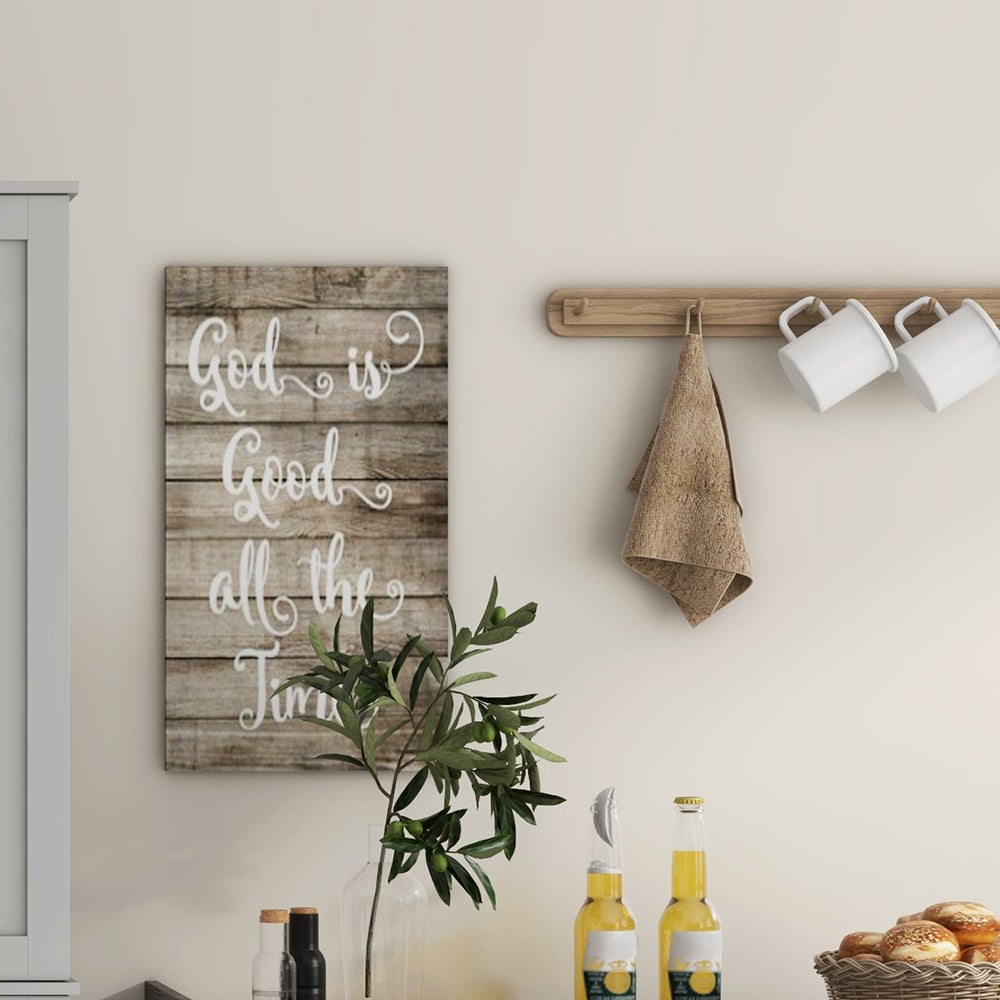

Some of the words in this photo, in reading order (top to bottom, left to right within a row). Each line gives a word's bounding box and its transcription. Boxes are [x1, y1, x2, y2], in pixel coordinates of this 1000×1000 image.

[188, 316, 334, 418] God
[347, 310, 425, 400] is
[222, 426, 392, 528] Good
[209, 539, 298, 637] all
[297, 531, 405, 620] the
[234, 639, 379, 731] Tim
